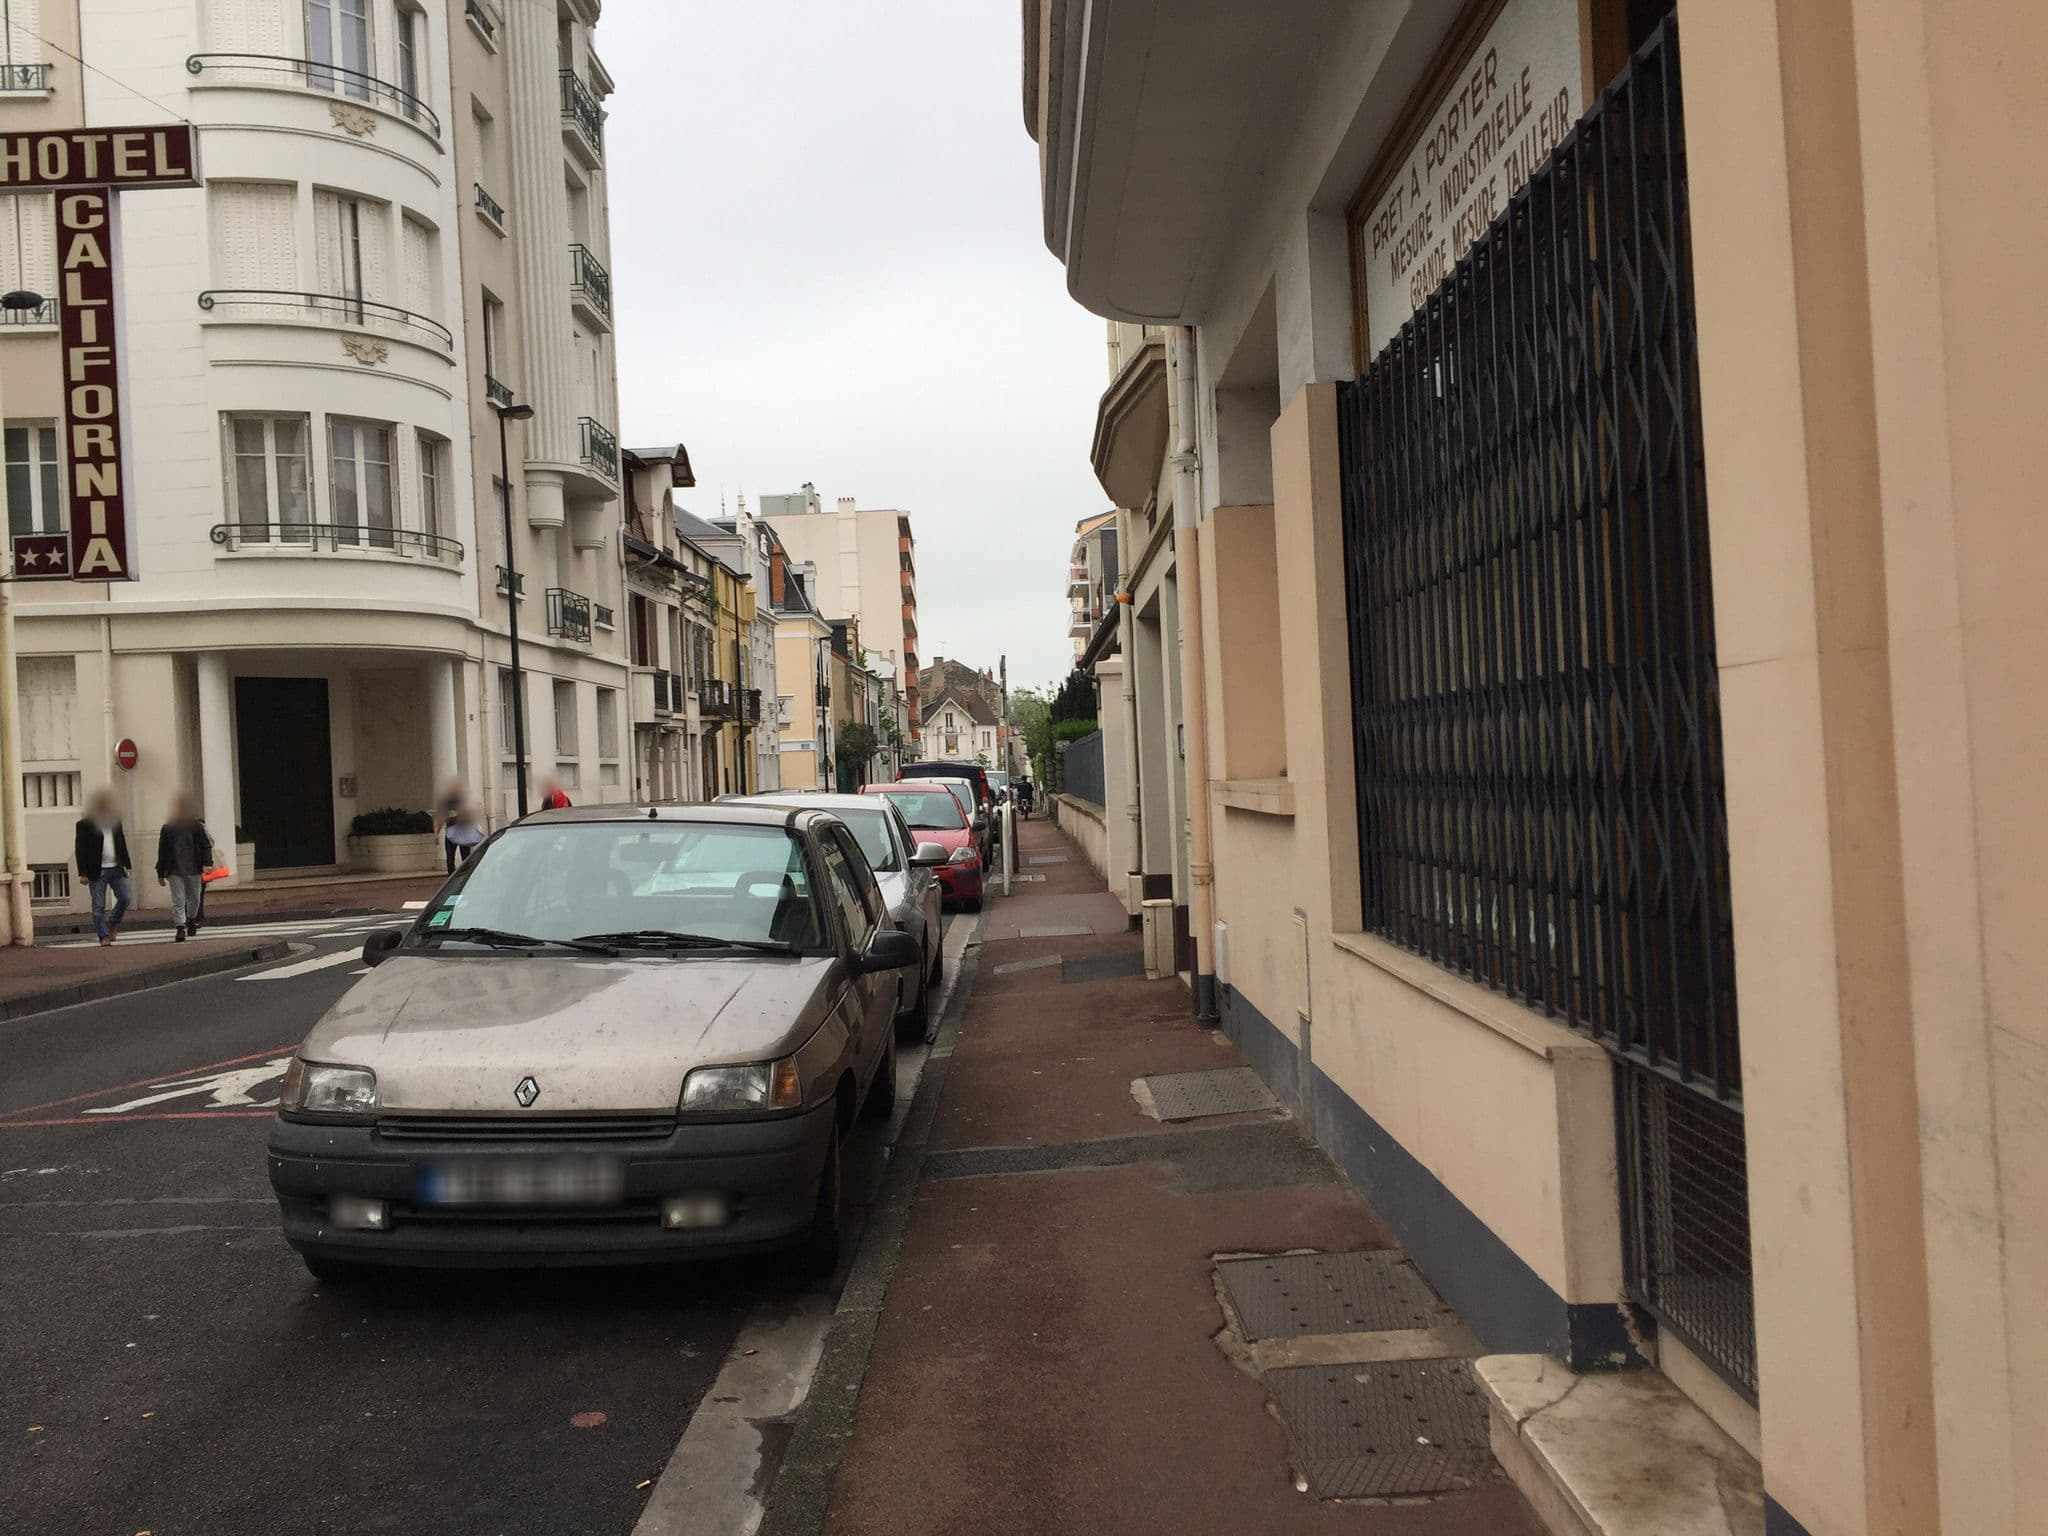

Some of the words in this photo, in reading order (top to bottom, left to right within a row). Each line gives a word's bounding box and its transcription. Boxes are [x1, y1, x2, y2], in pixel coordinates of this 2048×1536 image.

[0, 132, 185, 181] HOTEL
[1390, 200, 1434, 287] MESURE
[1439, 64, 1533, 223] INDUSTRIELLE
[1409, 238, 1448, 310] GRANDE
[1452, 176, 1498, 262] MESURE
[1503, 86, 1571, 199] TAILLEUR
[1425, 47, 1499, 184] PORTER
[62, 194, 122, 573] CALIFORNIA
